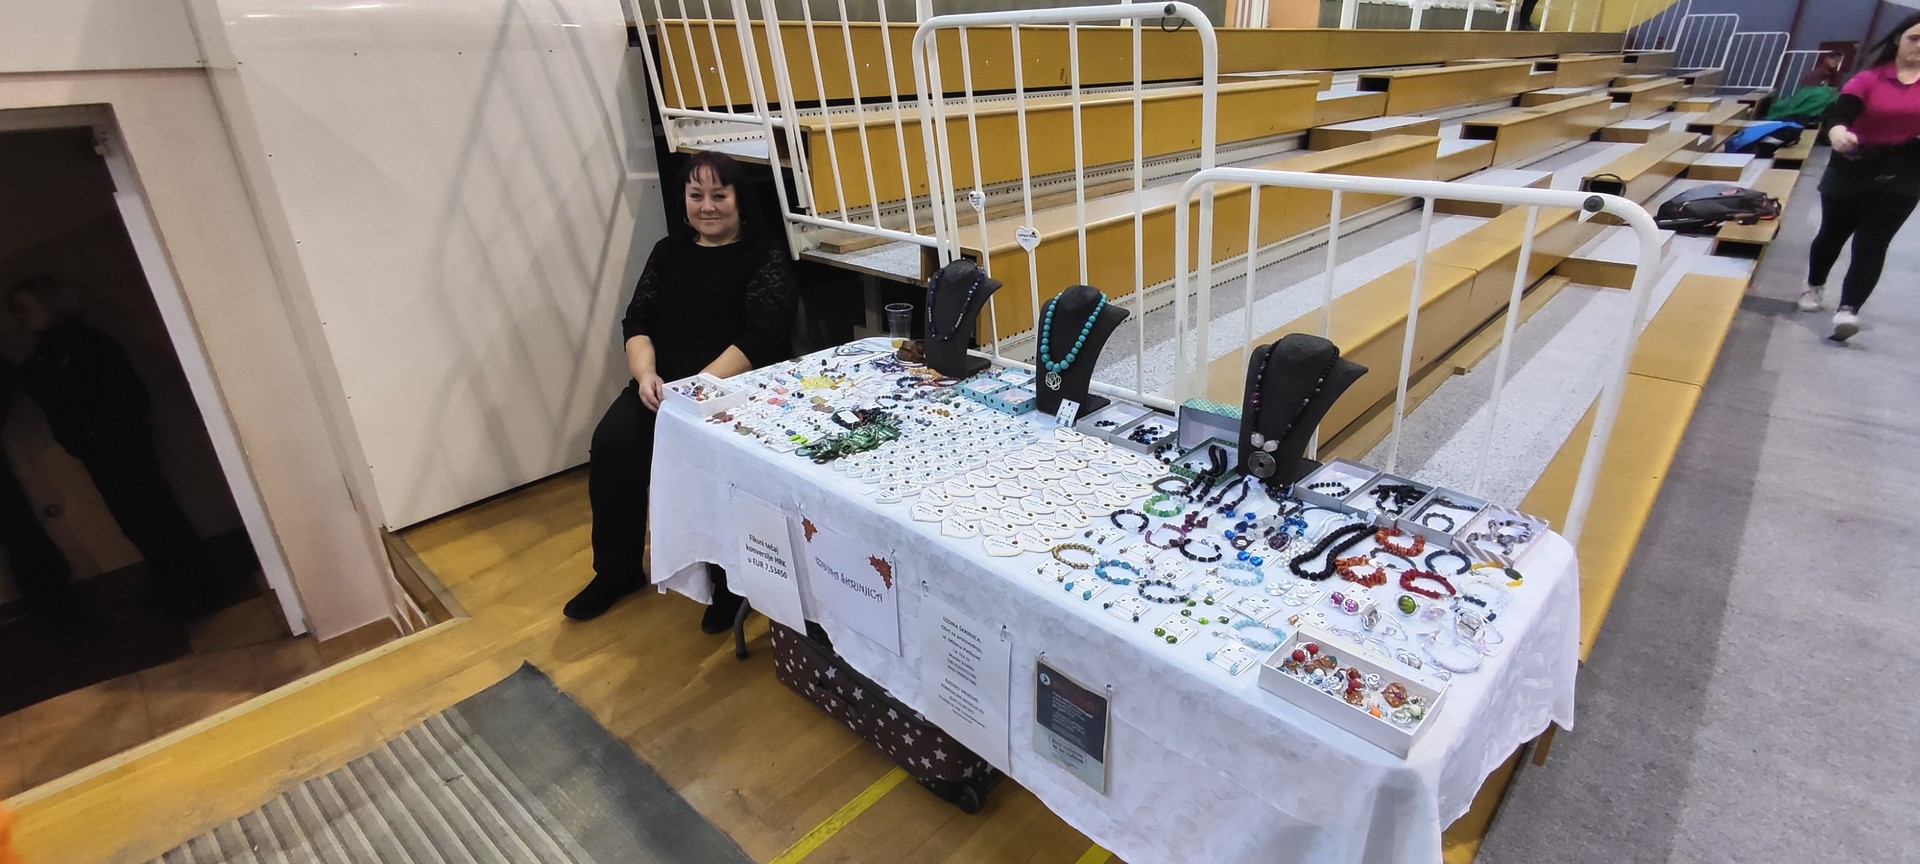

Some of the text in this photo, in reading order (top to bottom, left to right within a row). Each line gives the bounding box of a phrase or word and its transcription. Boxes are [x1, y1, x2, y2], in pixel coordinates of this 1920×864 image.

[745, 542, 773, 562] konverzije
[752, 557, 764, 569] EUR
[764, 562, 788, 580] 7,53450
